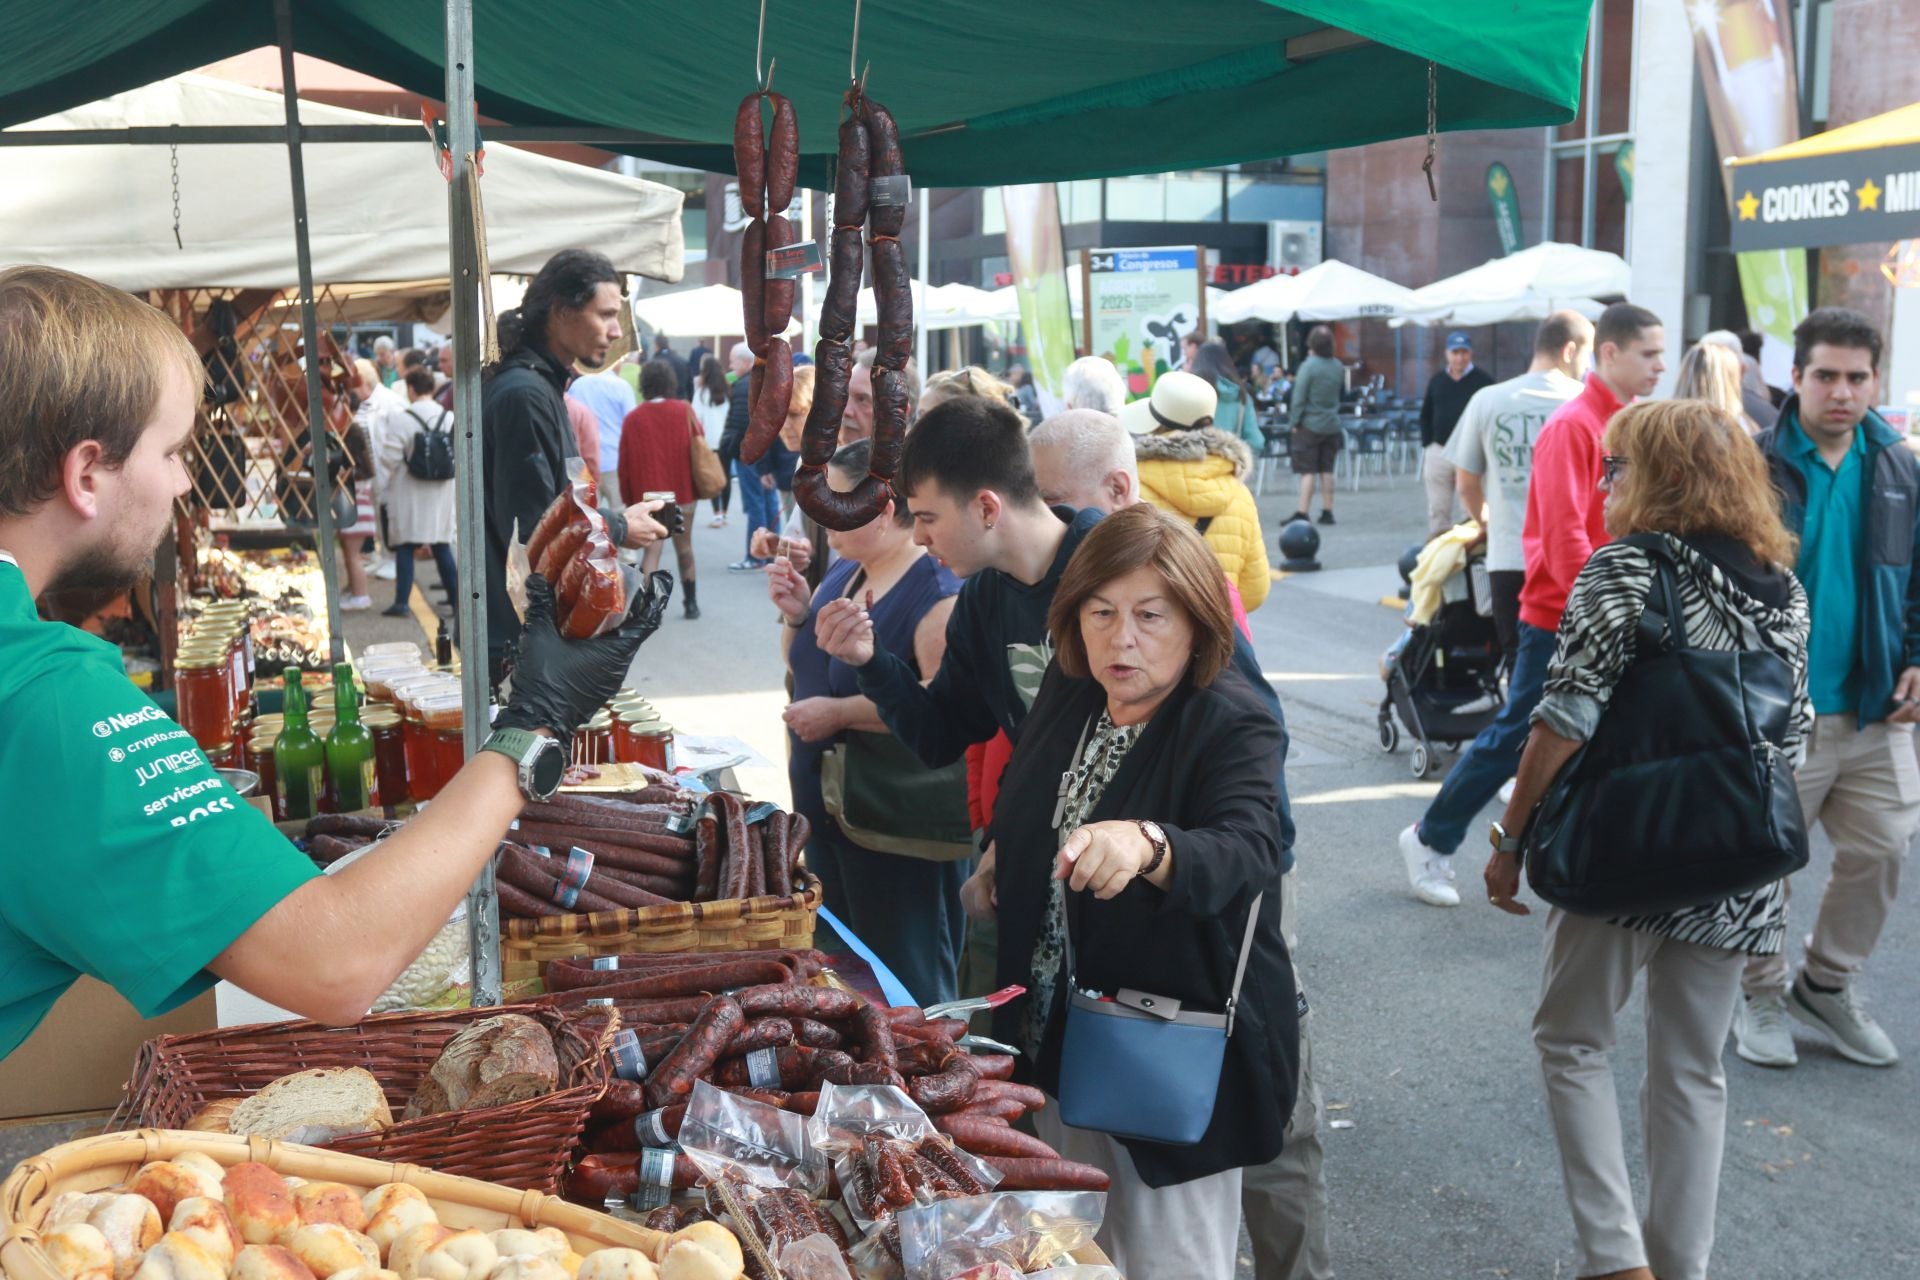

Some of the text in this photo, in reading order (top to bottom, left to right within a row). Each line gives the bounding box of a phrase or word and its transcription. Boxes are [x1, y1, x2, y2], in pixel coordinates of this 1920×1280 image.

[1762, 180, 1850, 223] COOKIES
[1090, 256, 1114, 270] 3-4
[1118, 258, 1179, 272] Congresos
[1100, 294, 1132, 310] 2025
[1498, 445, 1535, 467] ST
[108, 705, 170, 733] NexGe
[127, 730, 191, 753] crypto.com
